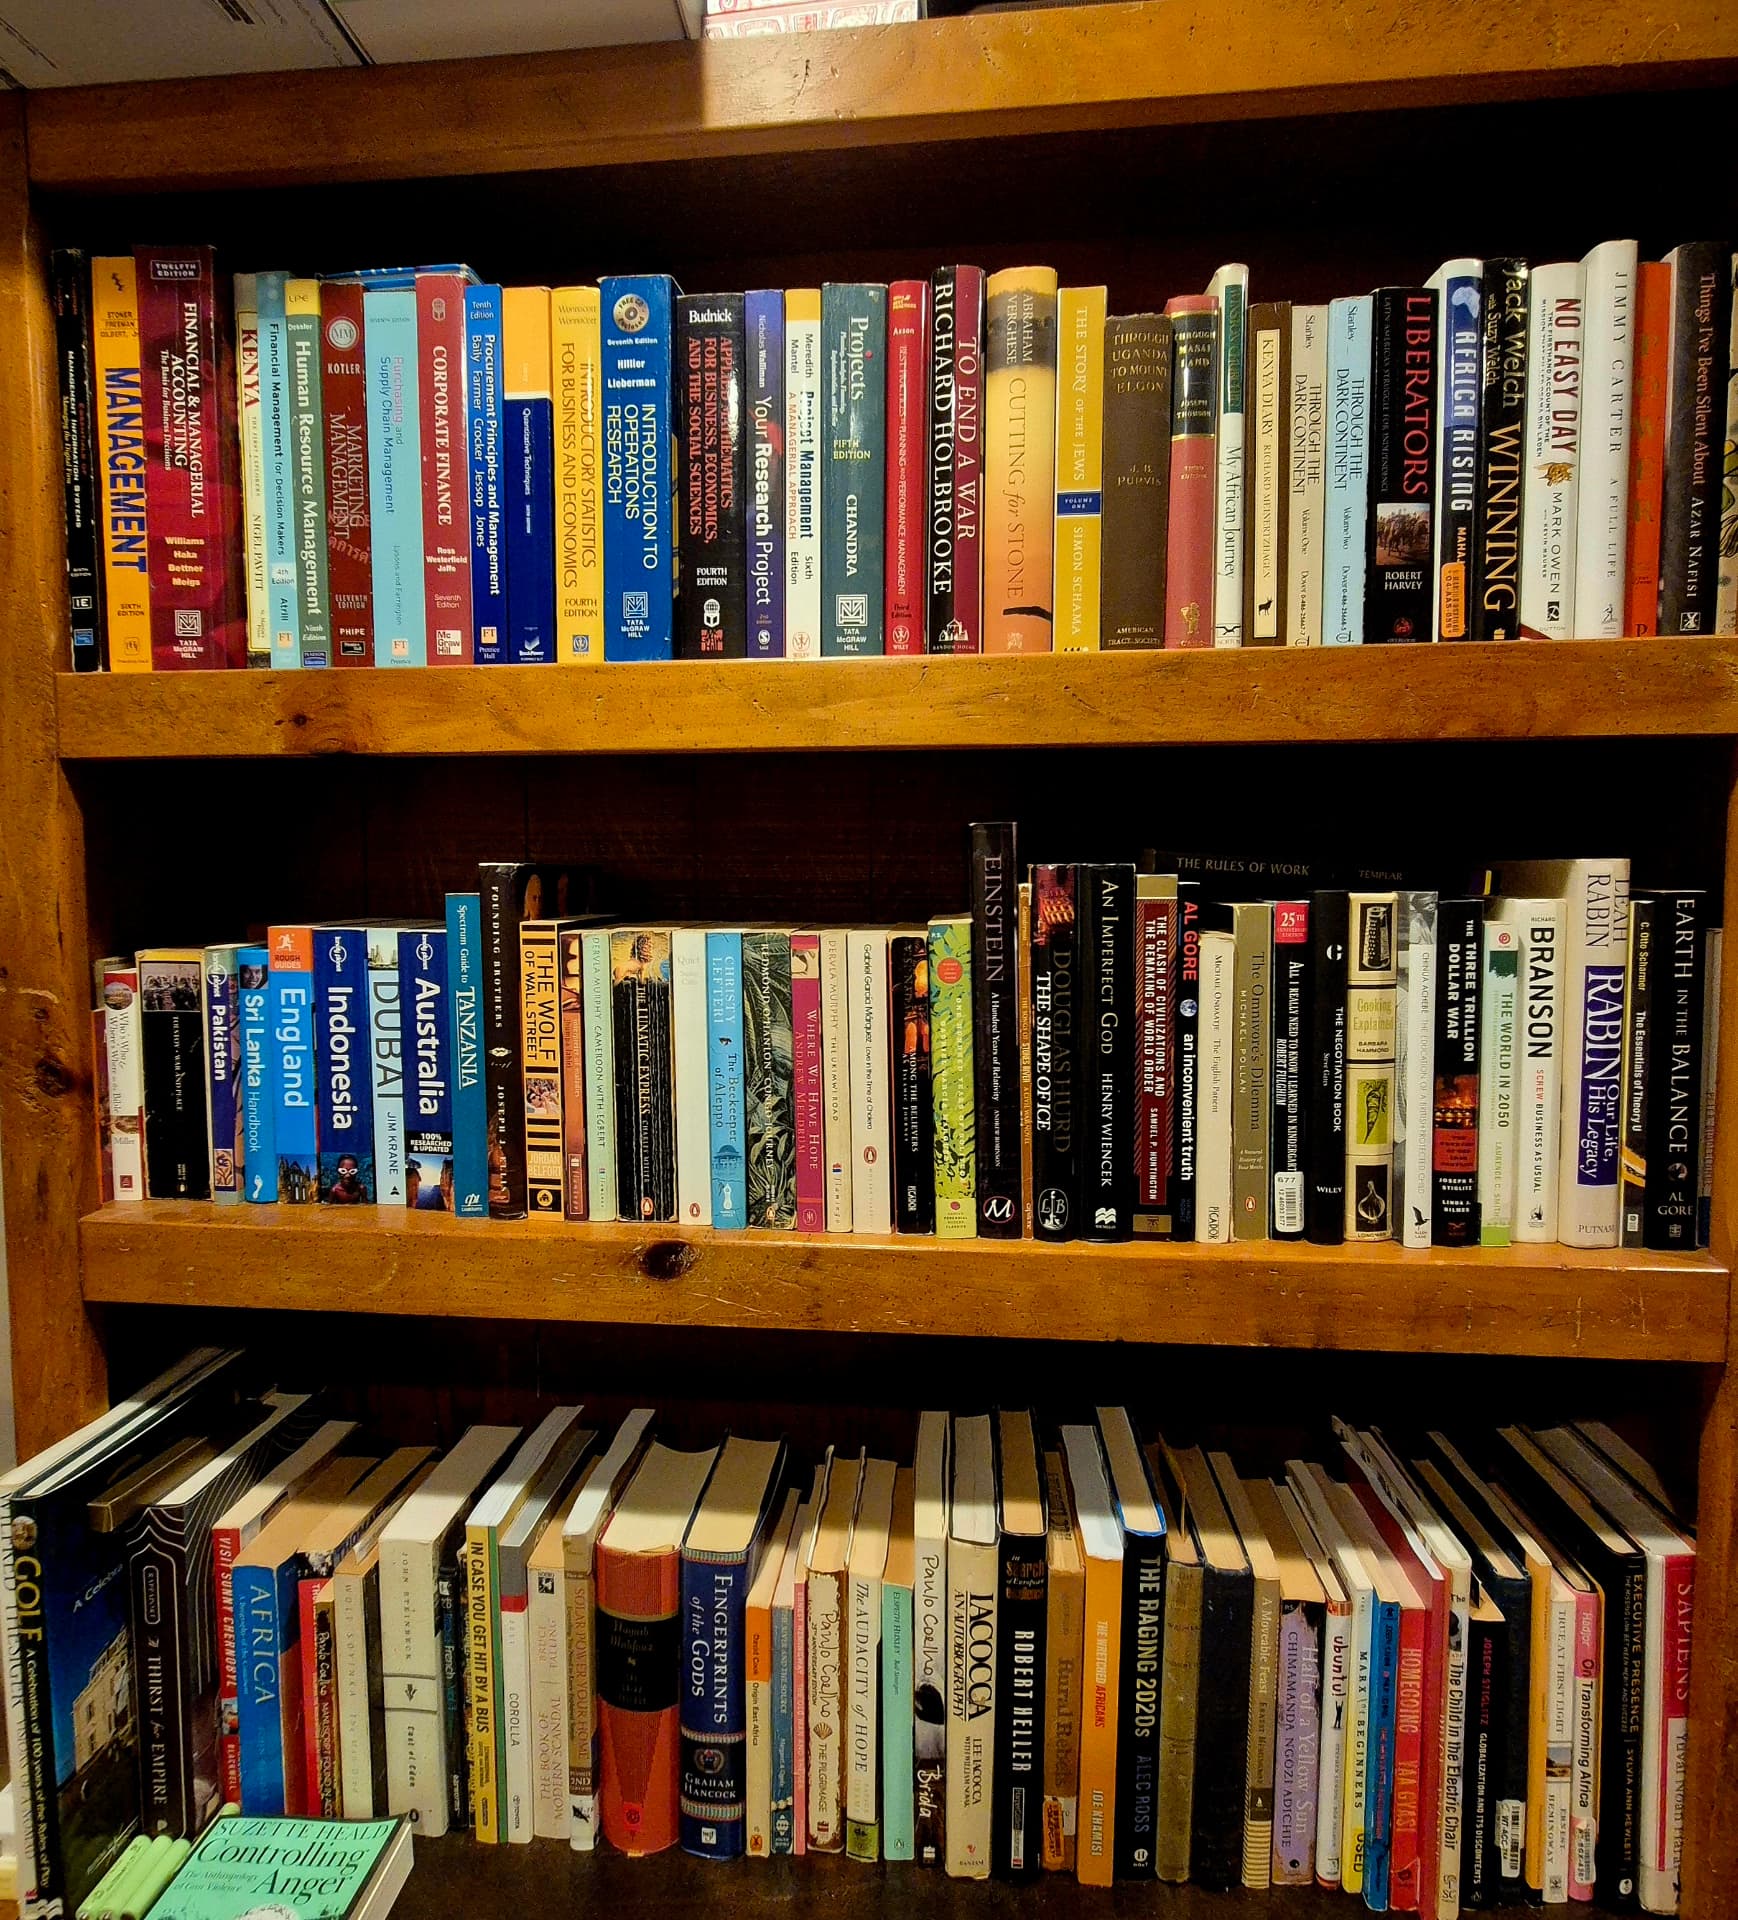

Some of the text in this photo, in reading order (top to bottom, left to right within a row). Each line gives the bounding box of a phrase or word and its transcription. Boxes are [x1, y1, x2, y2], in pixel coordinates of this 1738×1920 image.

[241, 328, 260, 408] KENYA
[328, 363, 361, 375] KOTLER
[689, 310, 732, 322] Budnick
[850, 316, 868, 401] Projects
[1007, 296, 1017, 364] VERGHESE
[1022, 294, 1033, 363] ABRAHAM
[172, 354, 187, 467] ACCOUNTING
[184, 302, 205, 518] FINANCIAL & MANAGERIAL
[433, 346, 452, 525] CORPORATE FINANCE
[1404, 297, 1431, 494] LIBERATORS
[1450, 332, 1478, 512] AFRICA RISING
[1551, 299, 1581, 454] NO EASY DAY
[104, 368, 148, 573] MANAGEMENT
[295, 341, 321, 616] Human Resource Management
[484, 335, 500, 595] Procurement Principles and Management
[607, 406, 622, 503] RESEARCH
[625, 404, 640, 519] OPERATIONS
[641, 404, 658, 569] INTRODUCTION TO
[933, 282, 953, 593] RICHARD HOLBROOKE
[957, 337, 976, 540] TO END A WAR
[1003, 377, 1026, 599] CUTTING for STONE
[166, 537, 204, 545] Williams
[426, 556, 468, 564] Westerfield
[753, 396, 773, 605] Your Research Project
[846, 494, 857, 577] CHANDRA
[1219, 447, 1241, 580] My African Journey
[1483, 424, 1521, 611] WINNING
[696, 577, 727, 585] EDITION
[1385, 571, 1422, 580] ROBERT
[1385, 581, 1423, 590] HARVEY
[984, 856, 1003, 982] EINSTEIN
[1183, 902, 1199, 980] AL GORE
[1586, 874, 1610, 948] RABIN
[213, 1005, 230, 1081] Pakistan
[276, 987, 309, 1107] England
[372, 981, 404, 1100] DUBAI
[415, 978, 445, 1115] Australia
[456, 987, 479, 1089] TANZANIA
[525, 951, 537, 1061] OF WALL STREET
[537, 952, 556, 1061] THE WOLF
[1035, 971, 1052, 1131] THE SHAPE OF ICE
[1447, 944, 1460, 1040] DOLLAR WAR
[1463, 942, 1476, 1062] THREE TRILLION
[1527, 928, 1555, 1058] BRANSON
[1584, 970, 1624, 1082] RABIN
[1669, 899, 1695, 1153] EARTH IN THE BALANCE
[244, 995, 266, 1152] Sri Lanka Handbook
[327, 987, 359, 1129] Indonesia
[1181, 1034, 1195, 1181] an inconvenient truth
[1333, 1007, 1343, 1132] THE NEGOTIATION BOOK
[387, 1136, 400, 1175] KRANE
[14, 1555, 42, 1641] GOLF
[219, 1537, 237, 1688] VISIT SUNNY CHERNOBYL
[250, 1584, 276, 1705] AFRICA
[470, 1541, 490, 1733] IN CASE YOU GET HIT BY A BUS
[690, 1596, 710, 1697] of the GODS
[714, 1575, 733, 1724] FINGERPRINTS
[922, 1555, 940, 1676] Paulo Coelho
[968, 1592, 993, 1721] IACOCCA
[1134, 1556, 1160, 1737] THE RAGING 2020s
[1675, 1582, 1695, 1702] SAPIENS
[509, 1692, 520, 1747] COROLLA
[852, 1583, 870, 1773] The AUDACITY of HOPE
[1012, 1630, 1034, 1772] ROBERT HELLER
[1332, 1635, 1349, 1697] ubuntu!
[1399, 1648, 1423, 1733] HOMEGOING
[1444, 1662, 1464, 1850] The Child in the Electric Chair
[1579, 1658, 1595, 1809] On Transforming Africa
[197, 1838, 370, 1875] Controlling
[215, 1821, 389, 1840] SUZETTE HEALD
[250, 1868, 353, 1905] Anger
